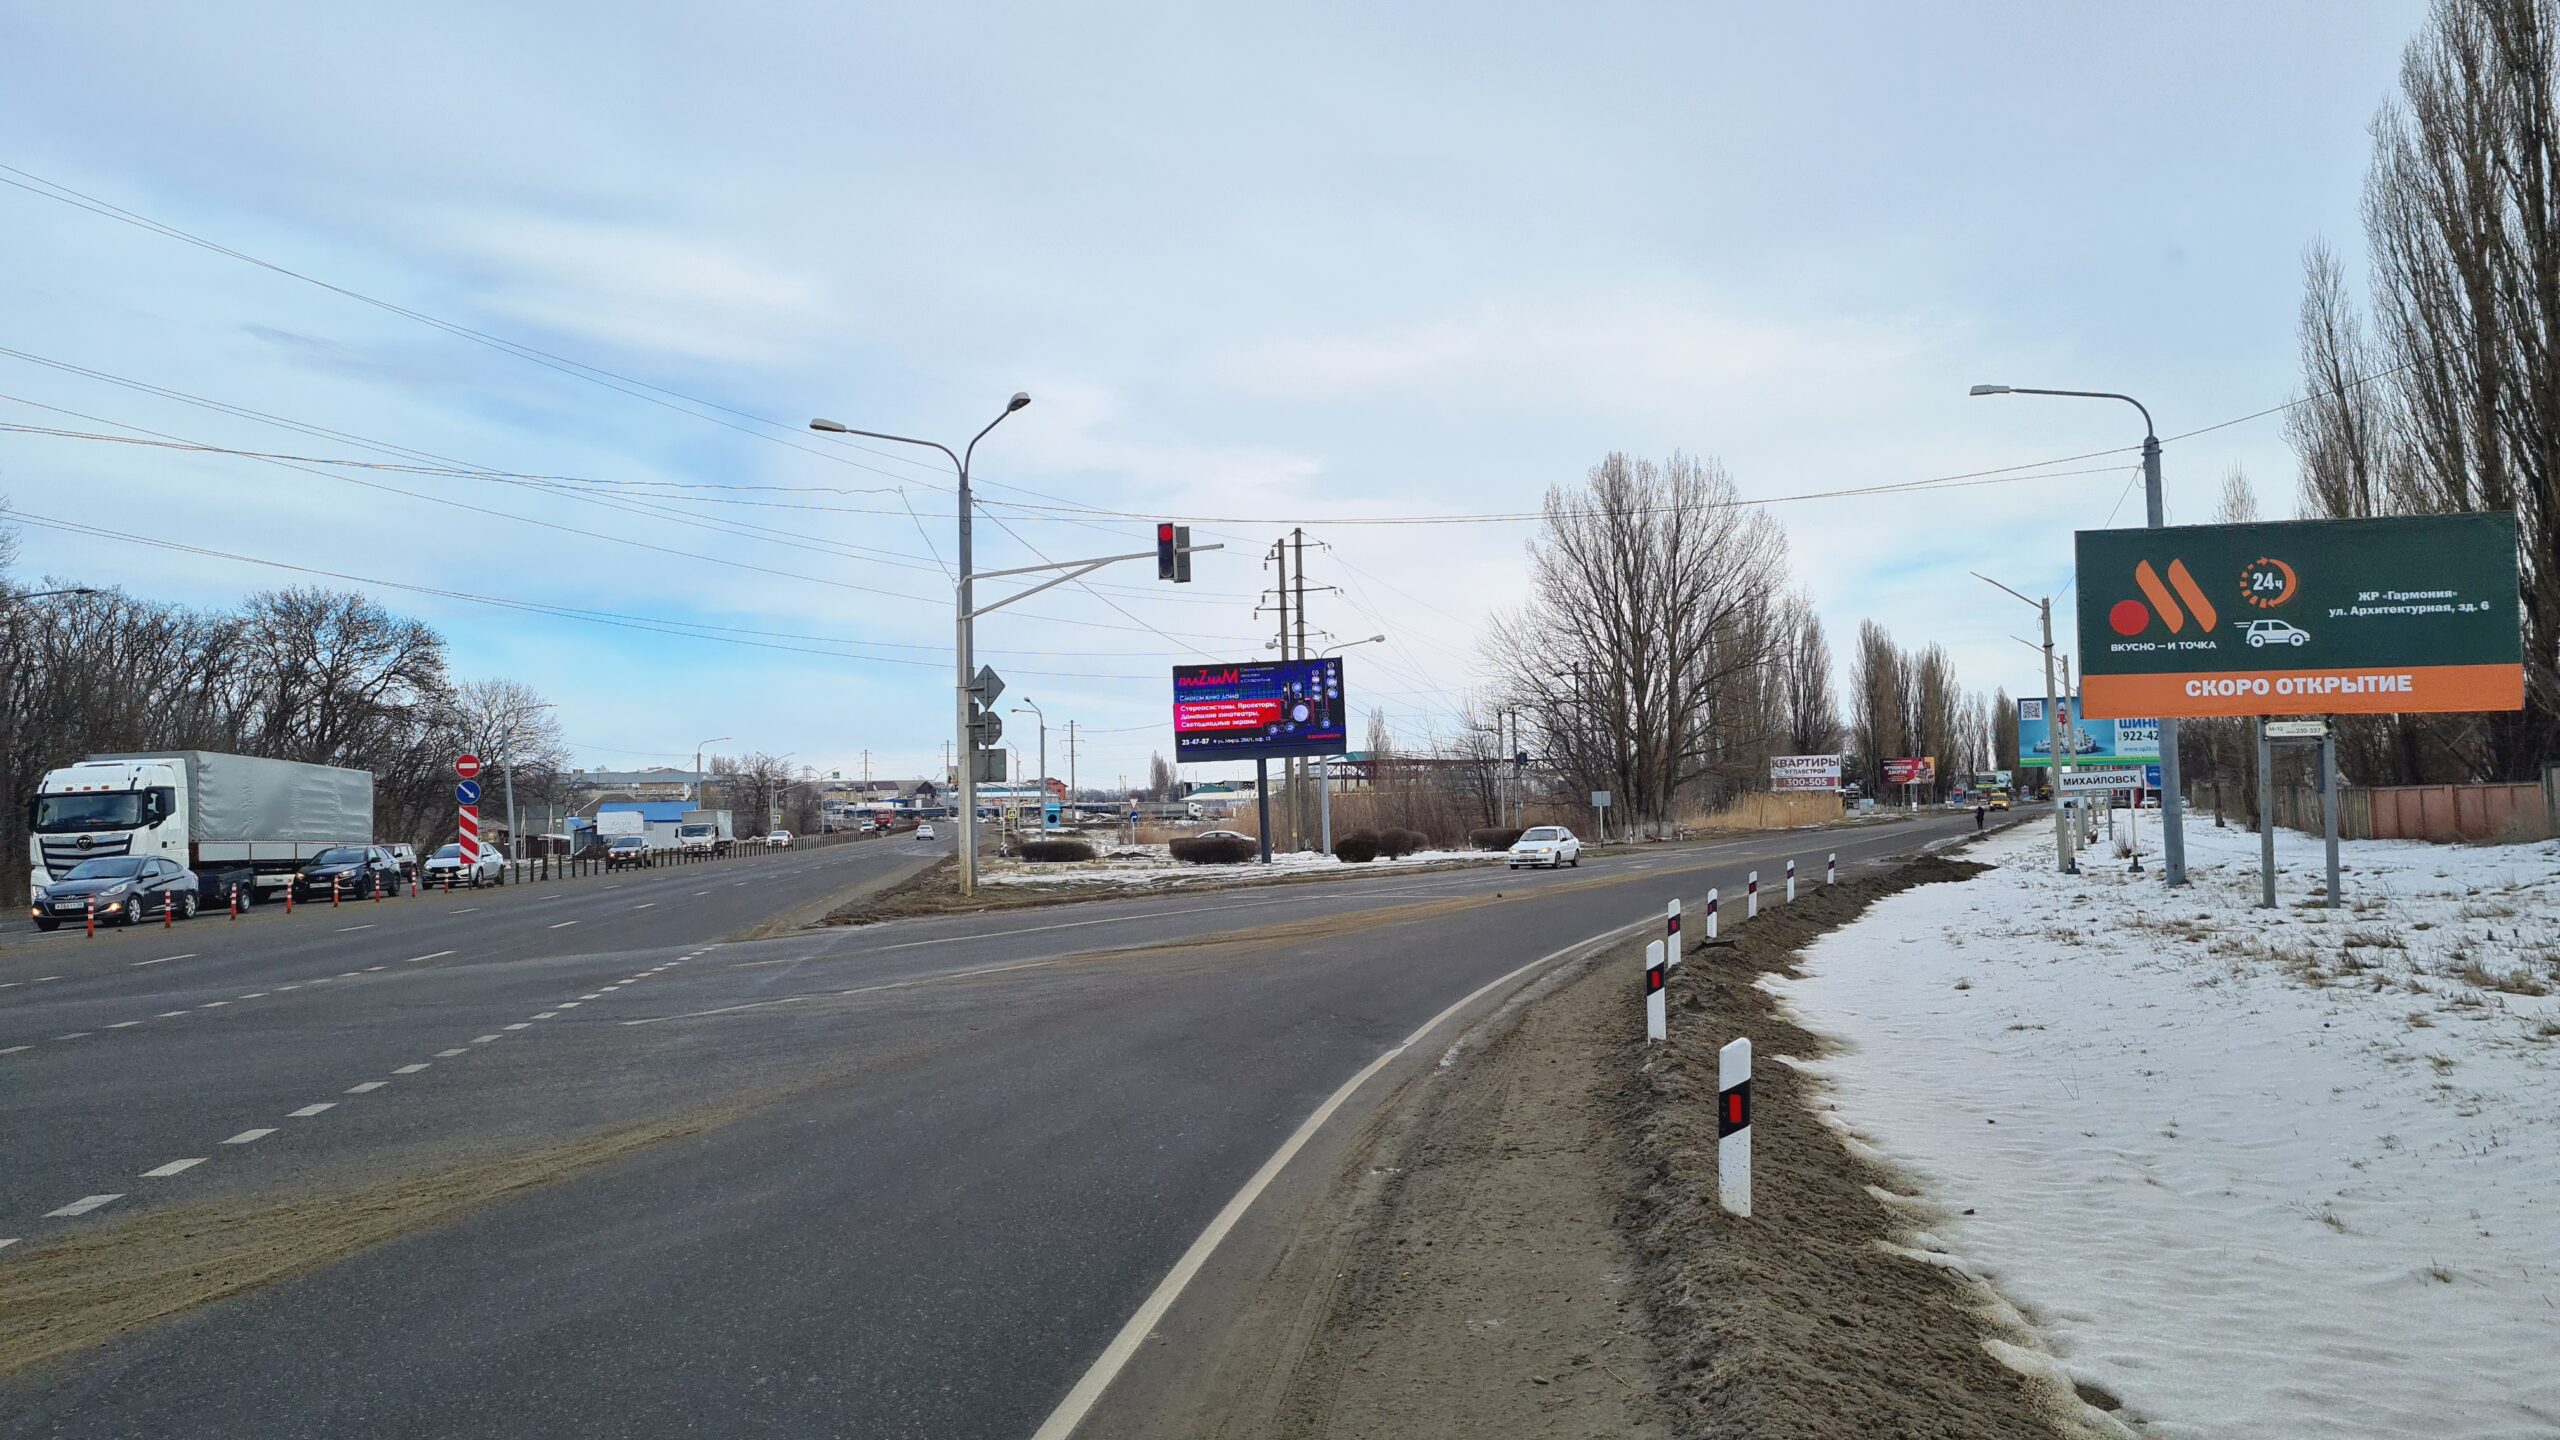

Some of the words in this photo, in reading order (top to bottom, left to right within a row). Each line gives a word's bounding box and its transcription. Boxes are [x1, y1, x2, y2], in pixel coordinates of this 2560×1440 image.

[2252, 572, 2283, 590] 24ч
[2358, 591, 2379, 601] ЖР
[2383, 590, 2457, 601] «Гармония»
[2329, 608, 2347, 617] ул.
[2350, 603, 2455, 616] Архитектурная,
[2458, 603, 2478, 612] зд.
[2480, 601, 2490, 610] 6
[2111, 642, 2155, 651] ВКУСНО
[2167, 642, 2176, 650] И
[2178, 641, 2217, 650] ТОЧКА
[2185, 678, 2270, 697] СКОРО
[2276, 674, 2413, 695] ОТКРЫТИЕ
[1181, 720, 1230, 728] Светодиодные
[1232, 718, 1257, 726] экраны
[1772, 757, 1840, 768] КВАРТИРЫ
[2063, 774, 2137, 786] МИХАЙЛОВСК
